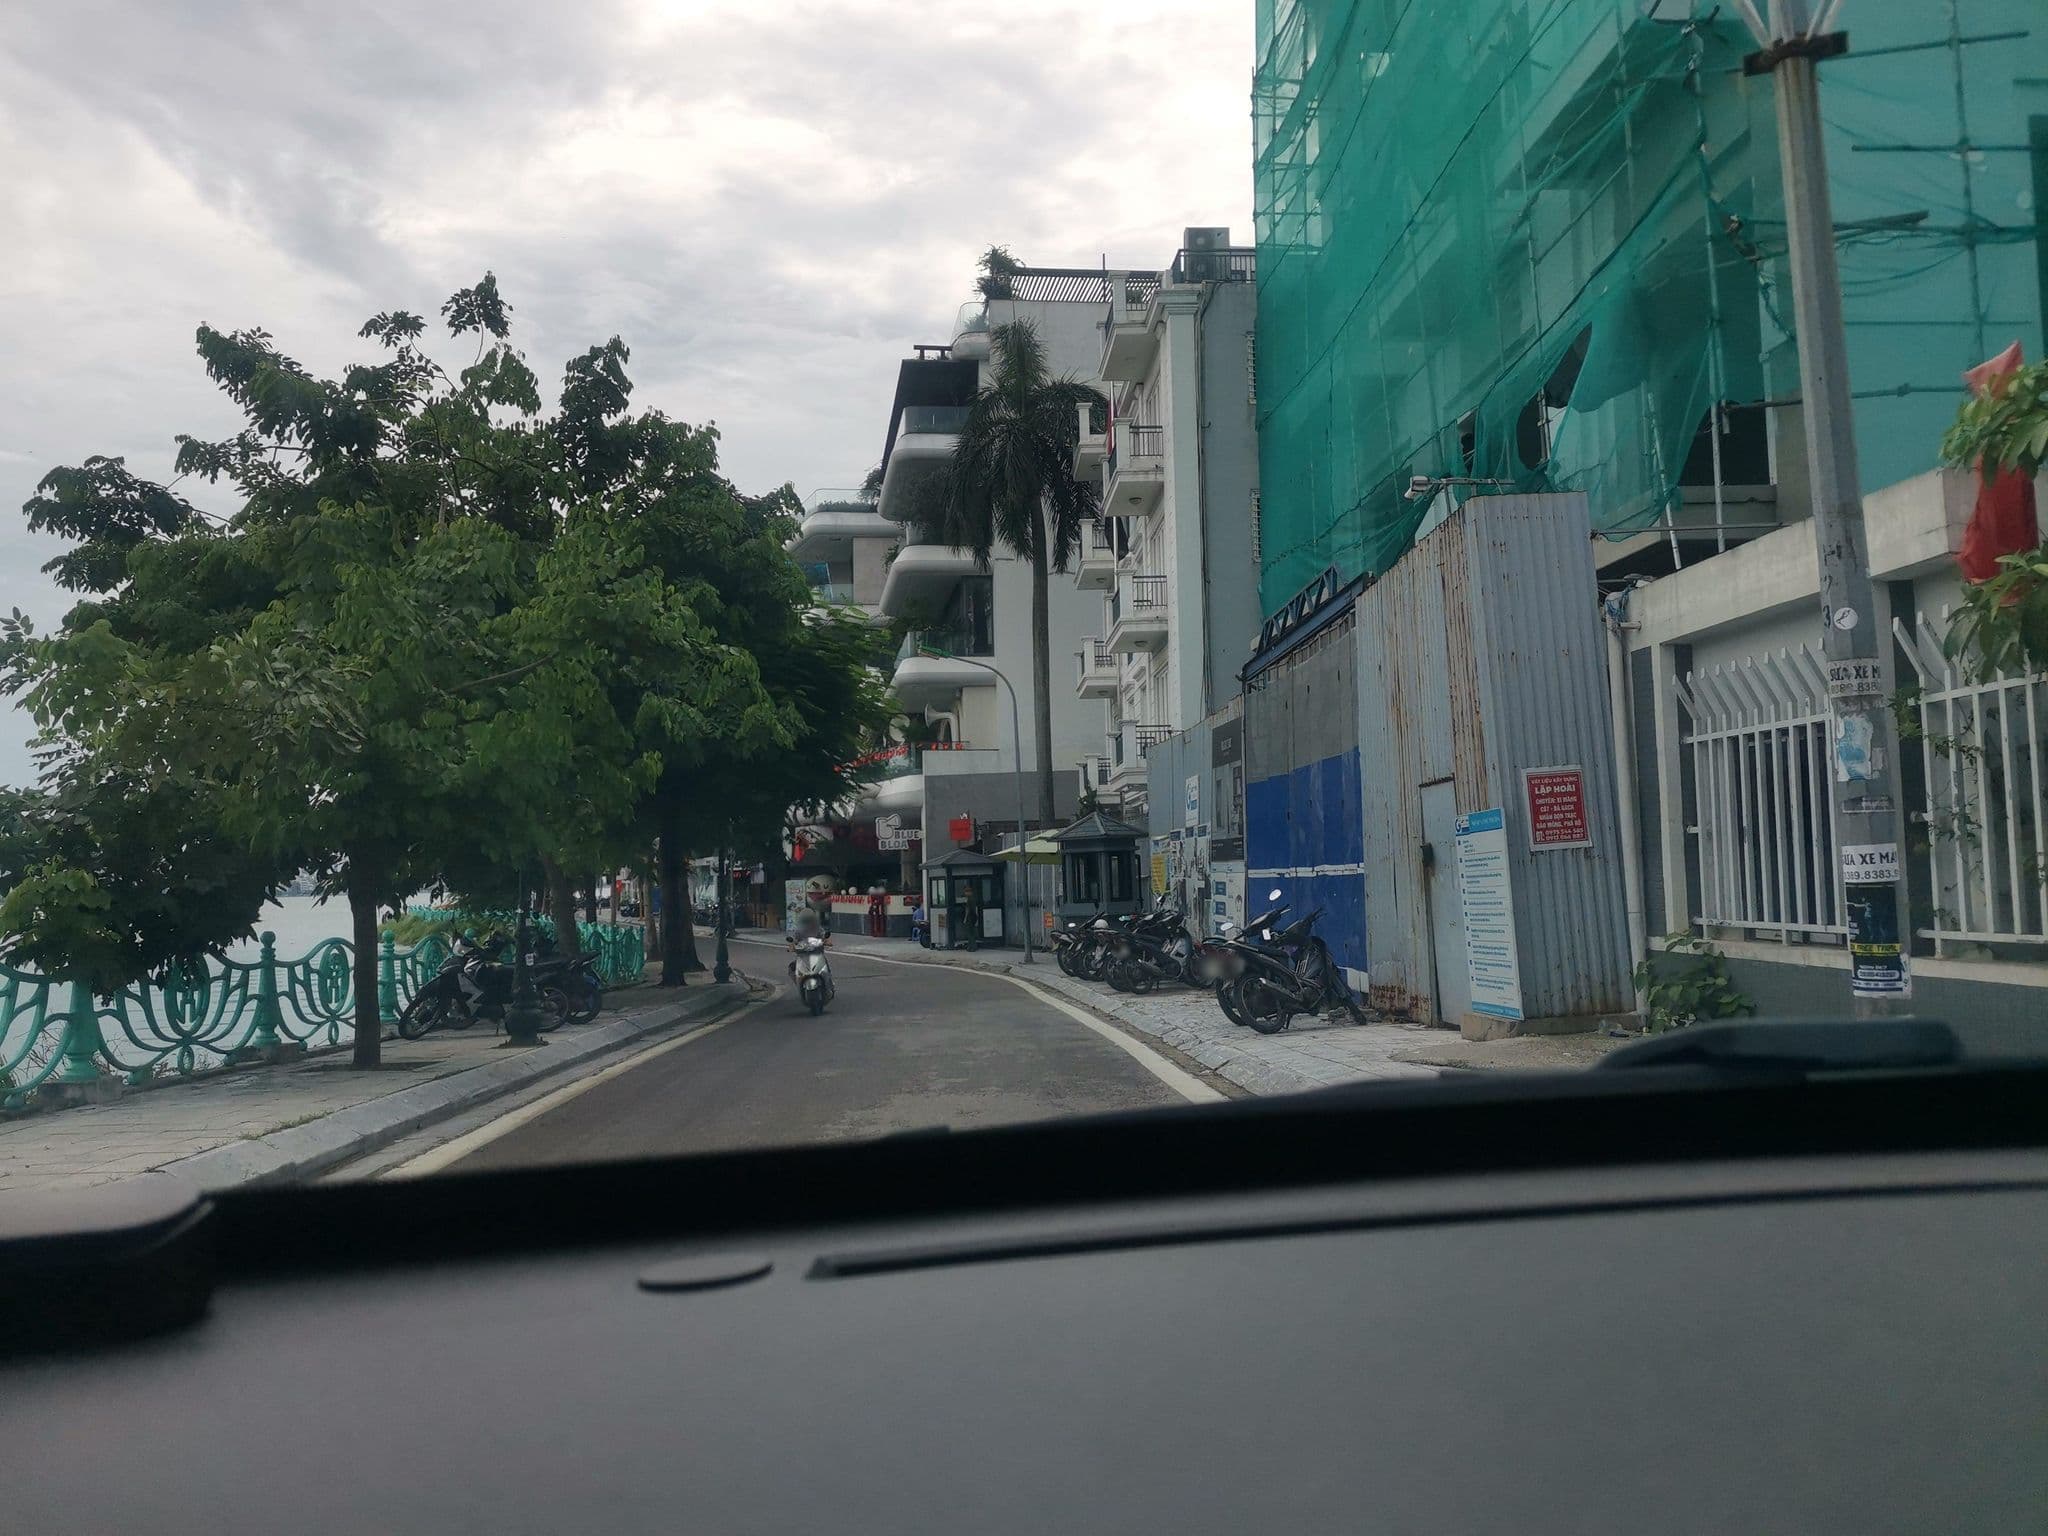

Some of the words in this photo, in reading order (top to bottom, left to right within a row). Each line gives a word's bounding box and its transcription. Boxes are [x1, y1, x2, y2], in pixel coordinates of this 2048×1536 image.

[1853, 665, 1869, 679] XE
[1535, 784, 1552, 796] LẬP
[894, 830, 920, 839] BLUE
[1859, 853, 1876, 865] XE
